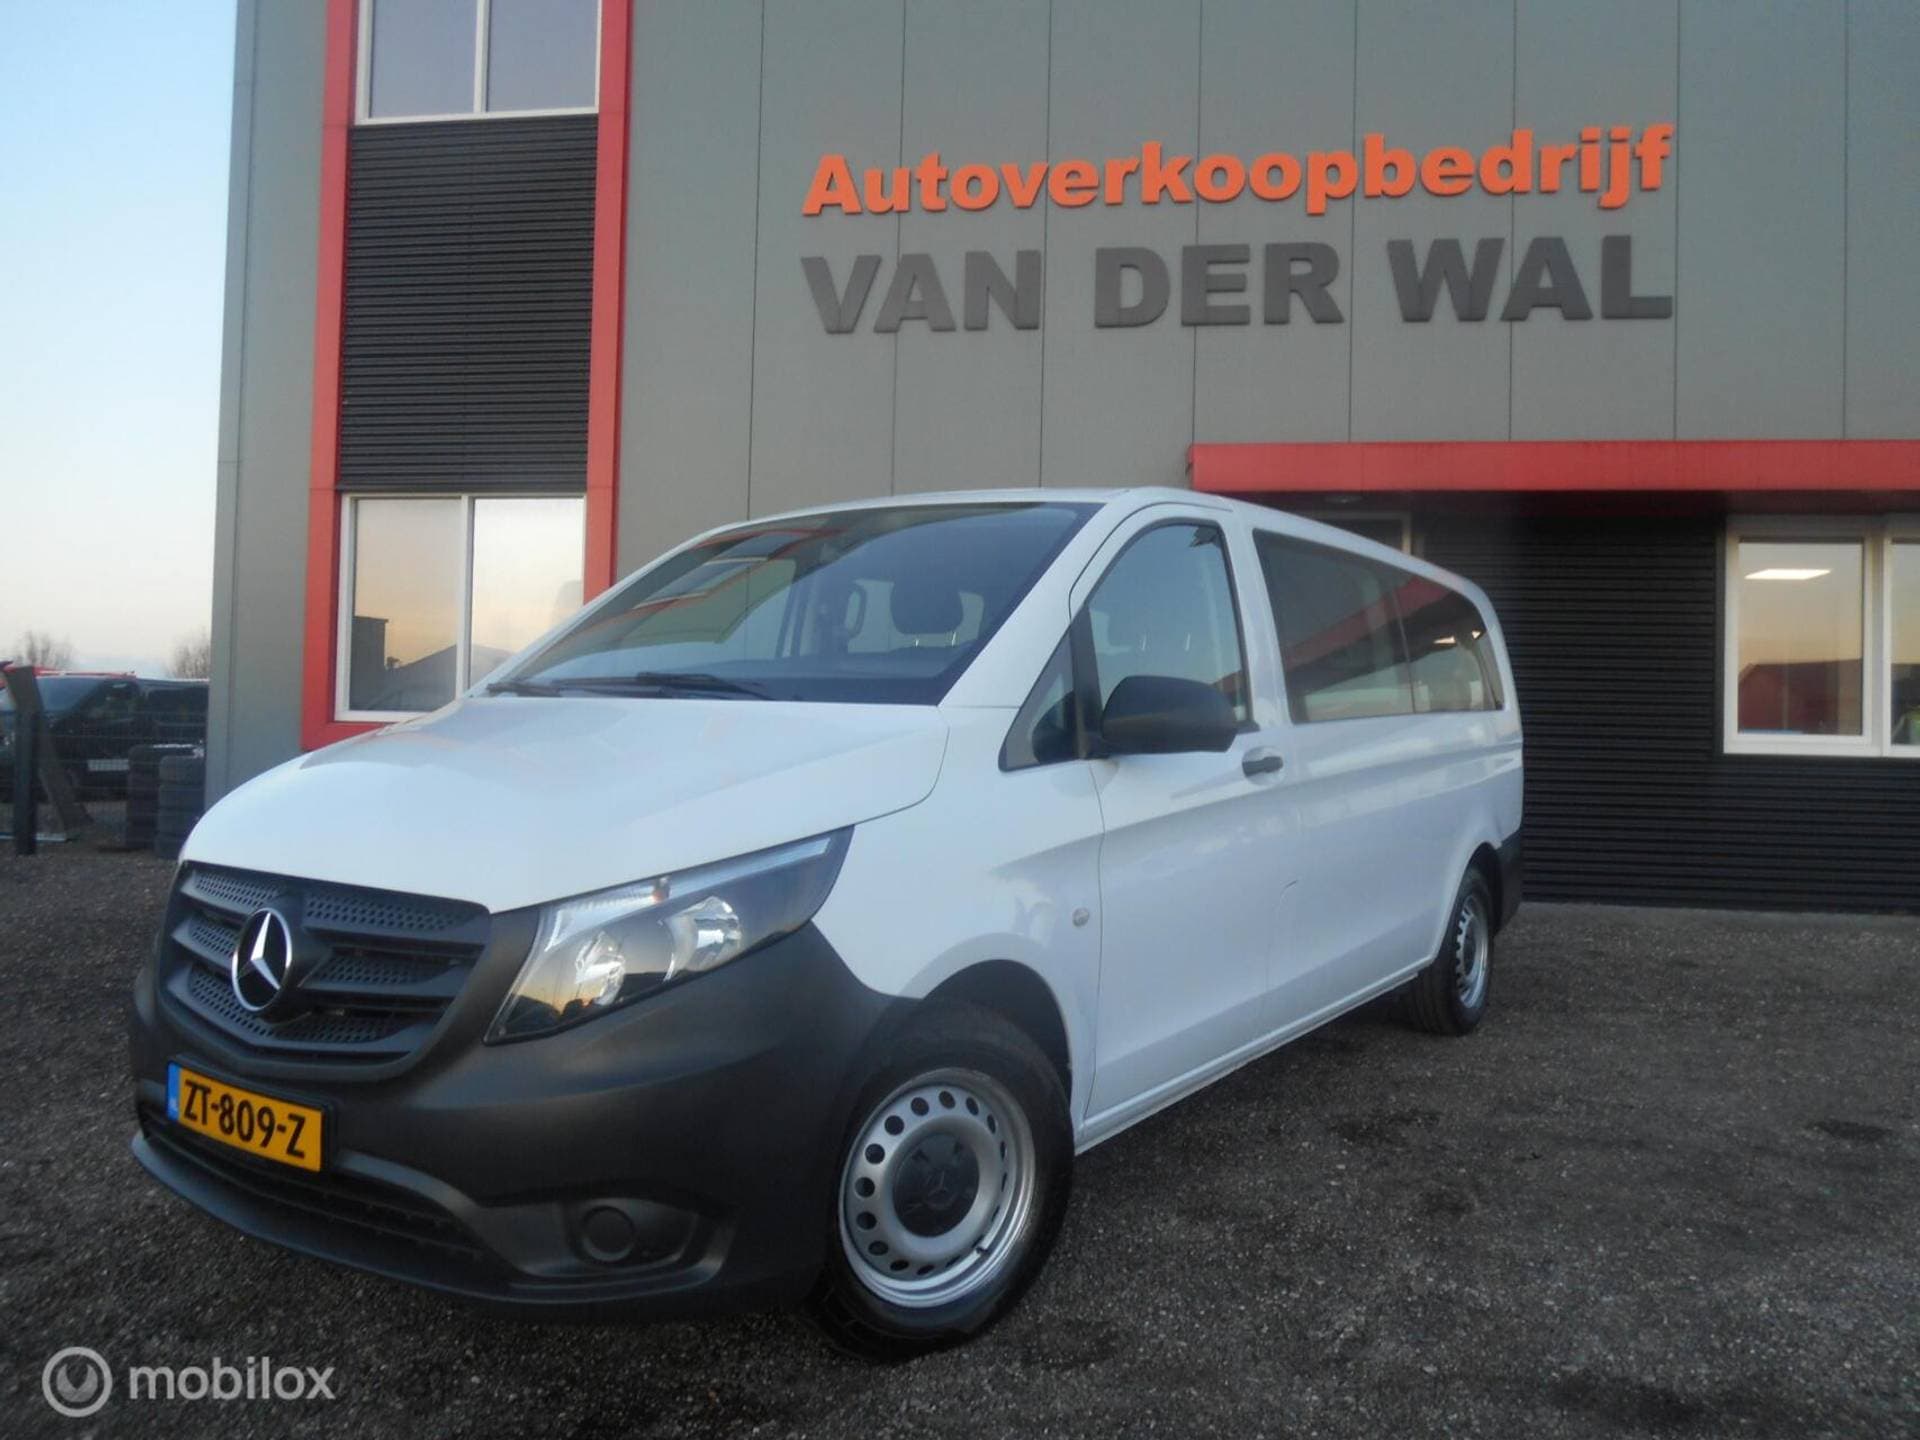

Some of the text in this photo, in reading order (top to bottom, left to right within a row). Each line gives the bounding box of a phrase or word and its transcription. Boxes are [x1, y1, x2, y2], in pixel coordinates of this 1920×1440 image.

[802, 124, 1674, 216] Autoverkoopbedrijf
[802, 235, 1673, 333] VAN DER WAL
[184, 1079, 307, 1160] ZT-809-Z
